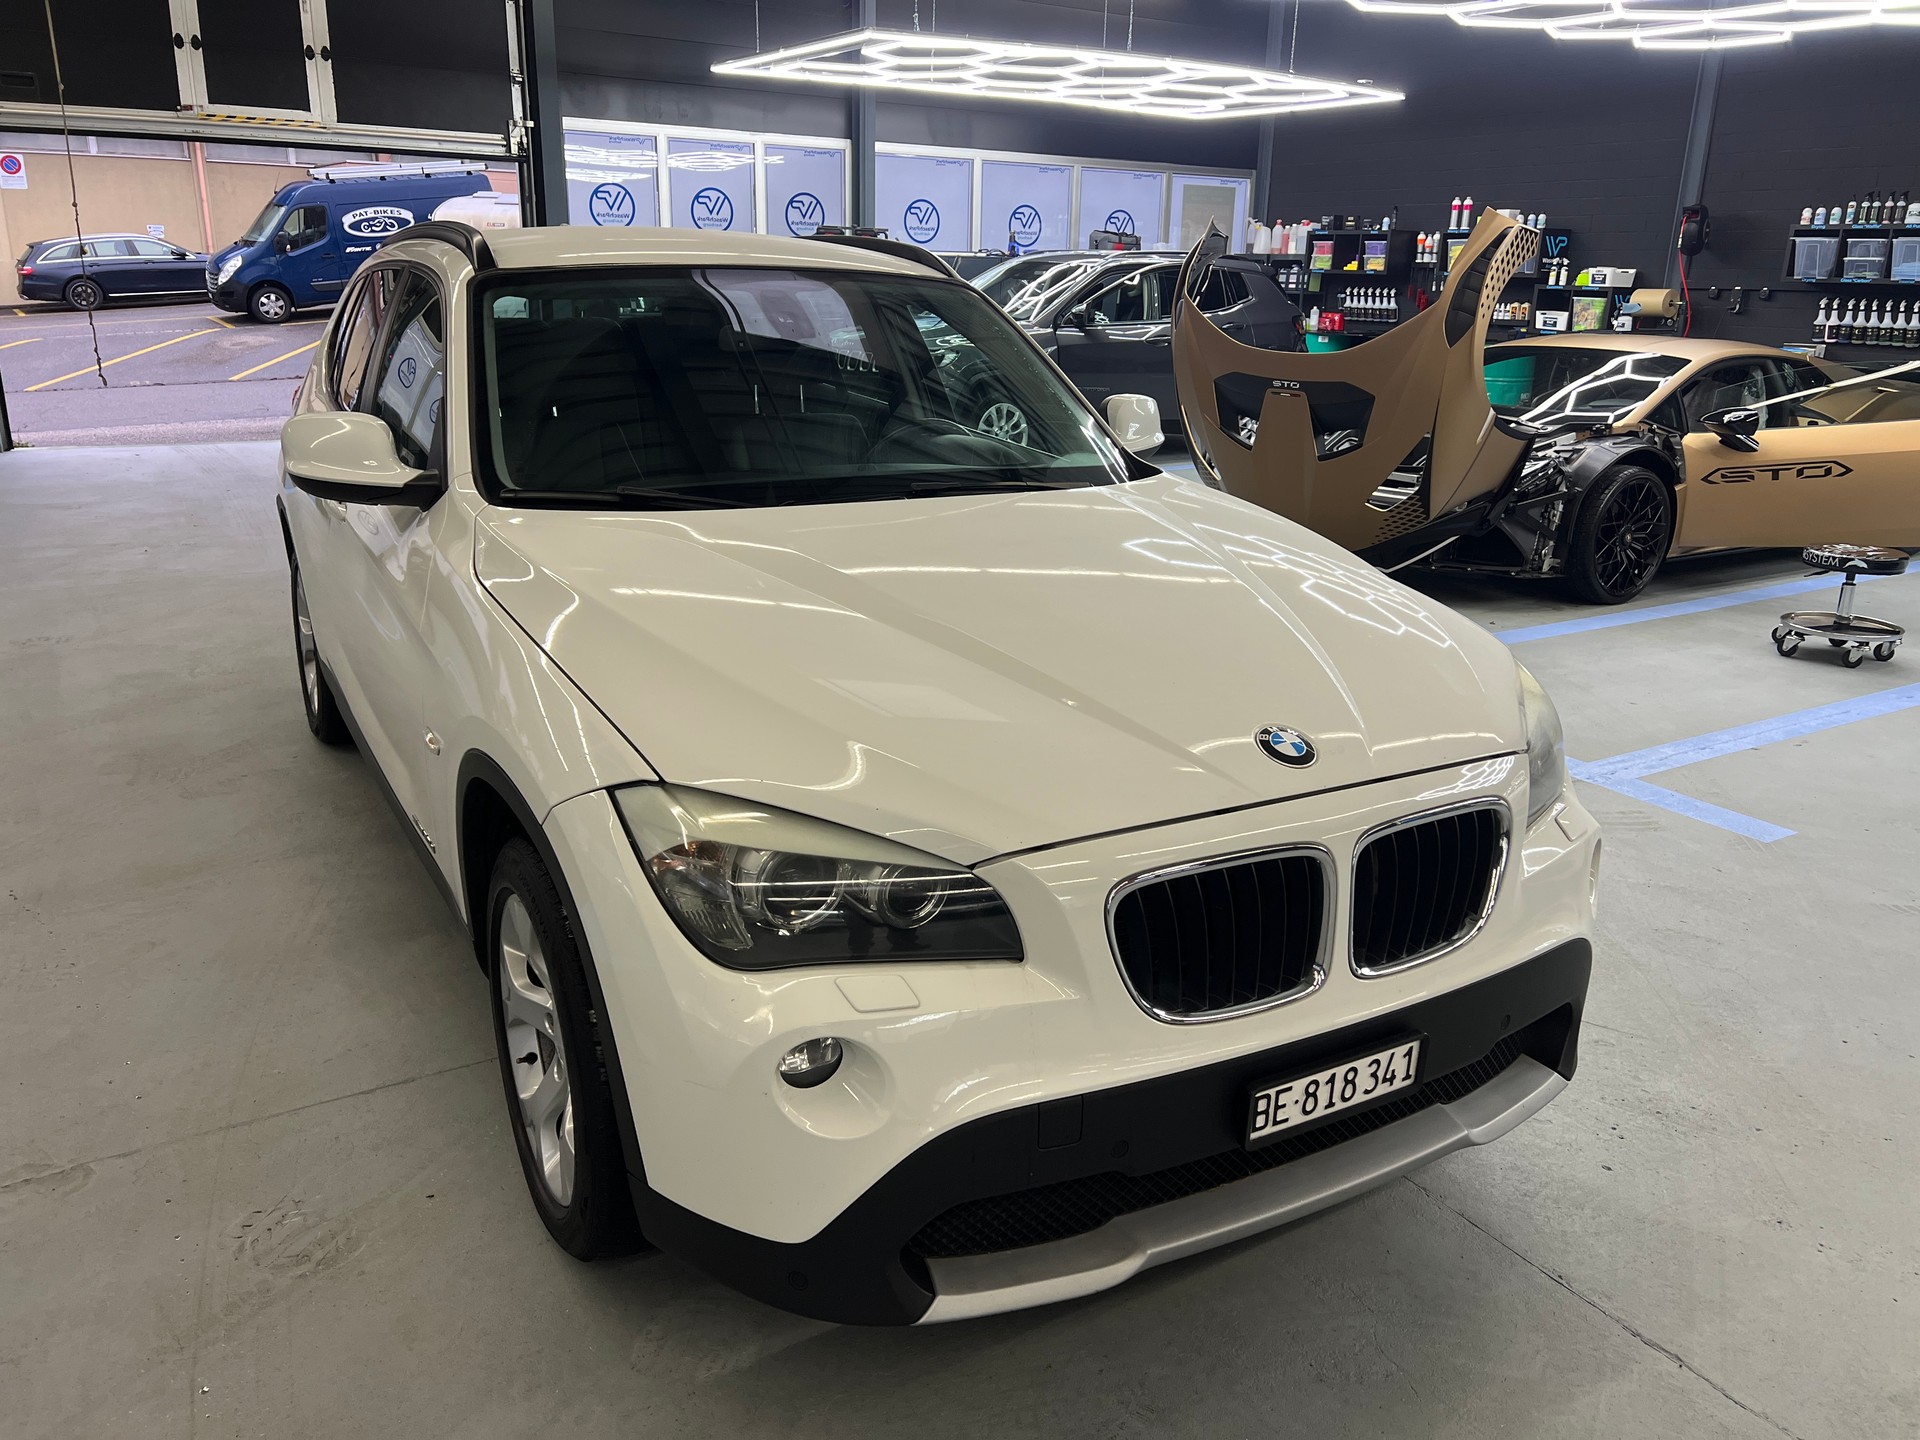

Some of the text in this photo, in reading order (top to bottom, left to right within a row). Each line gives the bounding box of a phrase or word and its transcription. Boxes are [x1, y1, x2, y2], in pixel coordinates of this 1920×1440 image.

[352, 208, 402, 219] PAT-BIKES
[1272, 380, 1300, 389] STO
[1720, 464, 1833, 483] STO
